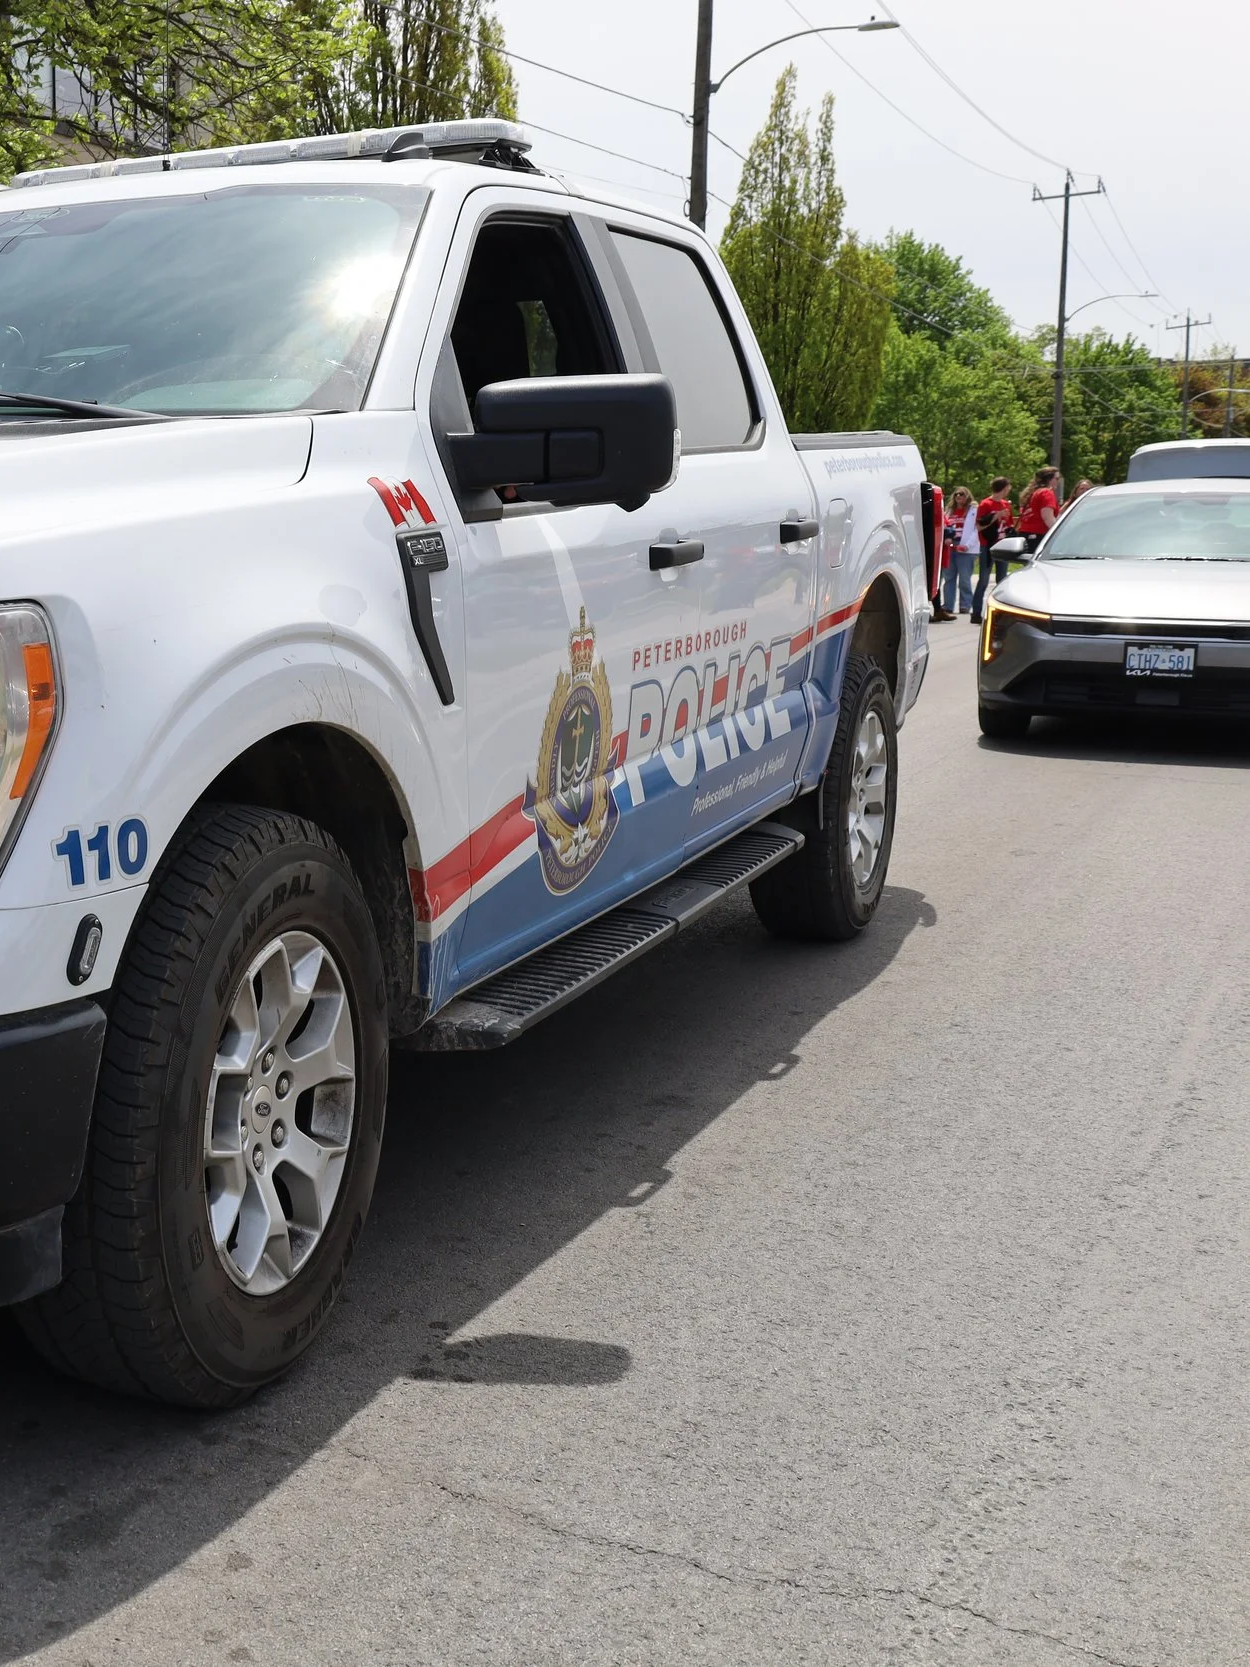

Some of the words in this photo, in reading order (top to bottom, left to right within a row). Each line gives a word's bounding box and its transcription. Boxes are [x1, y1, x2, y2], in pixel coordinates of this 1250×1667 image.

[413, 557, 424, 566] XL
[632, 620, 748, 671] PETERBOROUGH
[1168, 654, 1191, 670] 581
[624, 636, 792, 807] POLICE
[55, 818, 148, 886] 110
